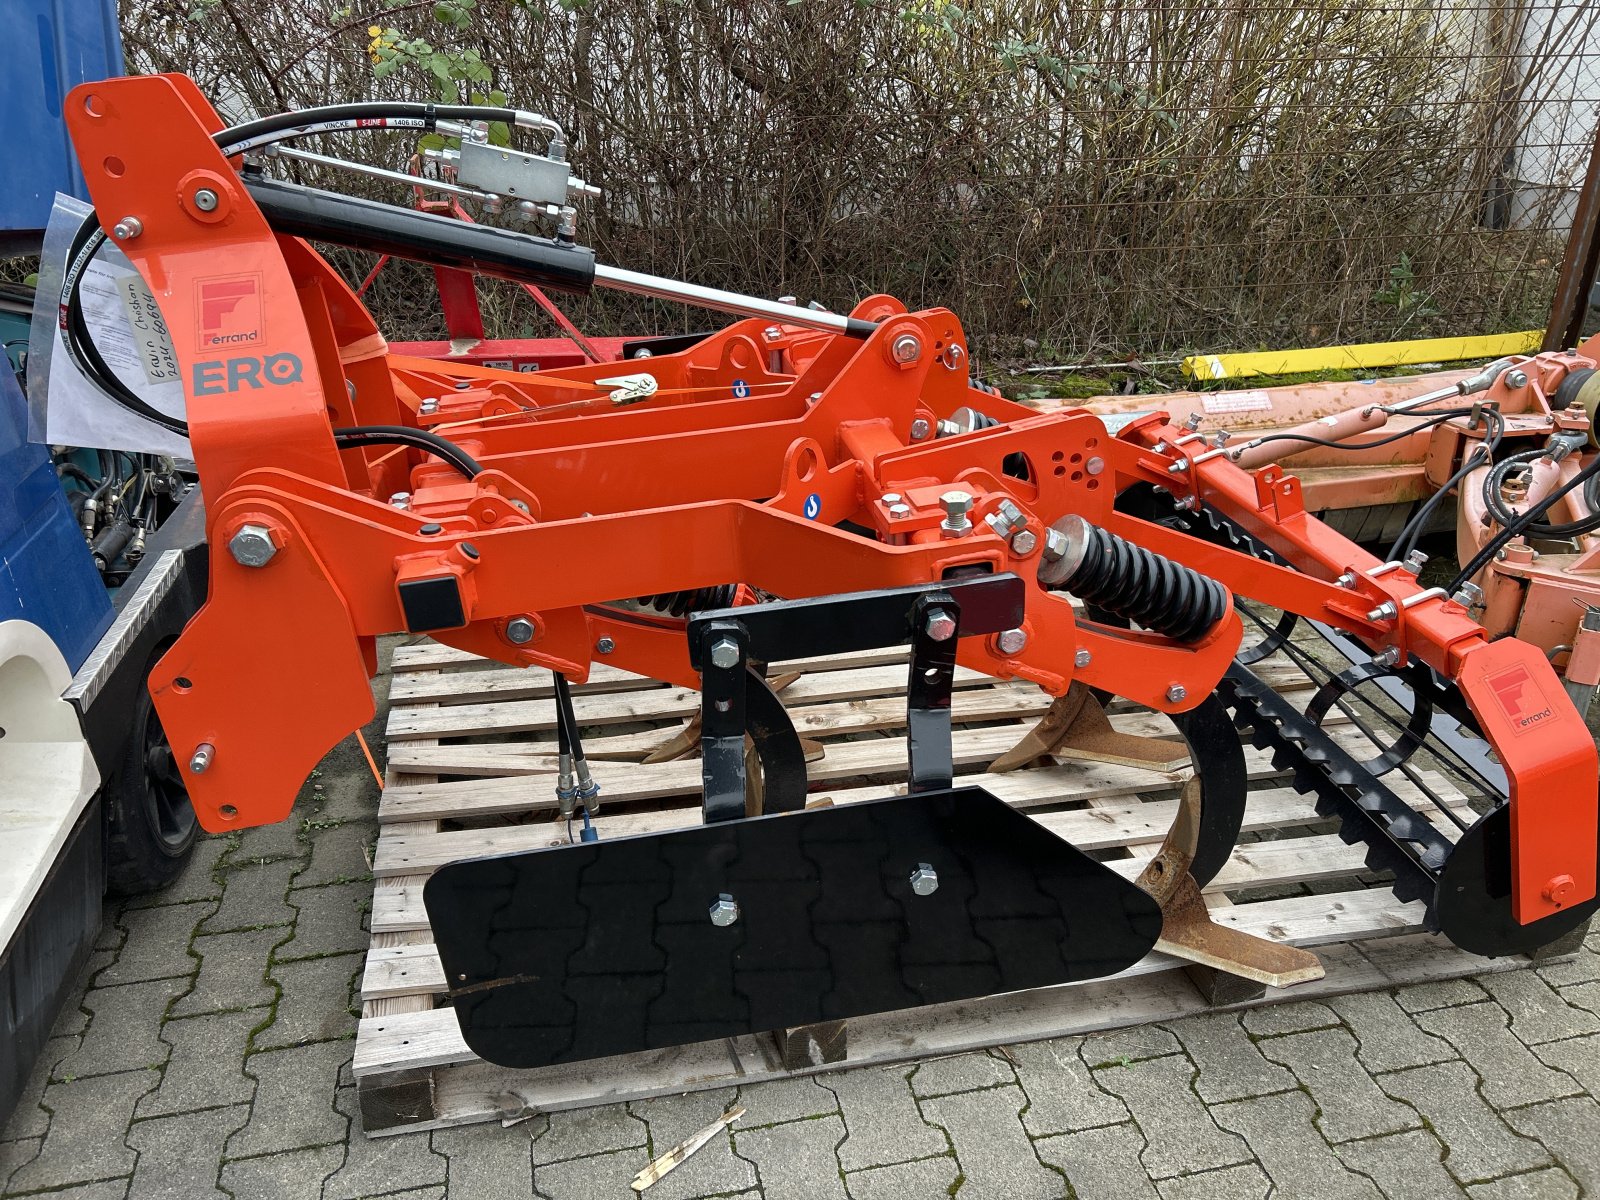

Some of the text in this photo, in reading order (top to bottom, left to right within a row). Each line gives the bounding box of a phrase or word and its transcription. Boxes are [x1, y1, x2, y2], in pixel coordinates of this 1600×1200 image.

[324, 121, 349, 129] VINCKE
[63, 285, 71, 298] 1406
[203, 330, 257, 346] Ferrand
[1513, 707, 1551, 728] Ferrand
